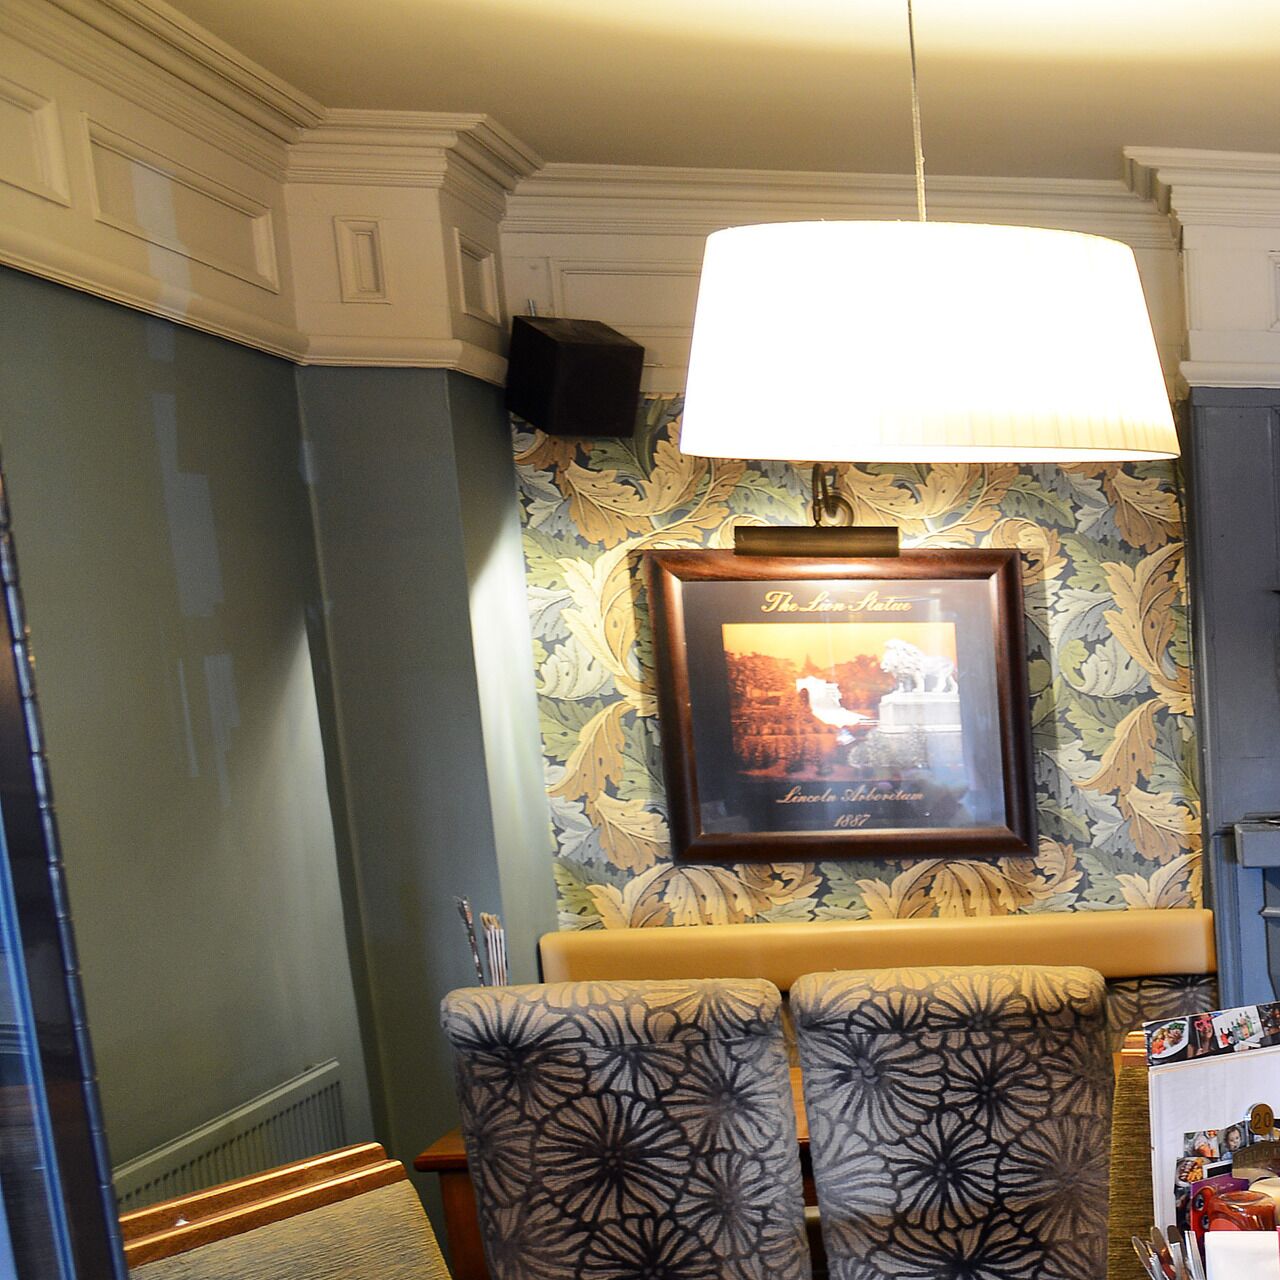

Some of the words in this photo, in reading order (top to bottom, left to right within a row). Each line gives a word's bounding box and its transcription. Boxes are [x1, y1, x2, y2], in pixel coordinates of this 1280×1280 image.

[761, 591, 799, 612] The
[800, 591, 848, 612] Lion
[848, 591, 912, 612] Statue
[776, 785, 837, 804] Lincoln
[840, 784, 925, 802] Arboretum
[833, 814, 872, 828] 1887
[1253, 1113, 1272, 1130] 20
